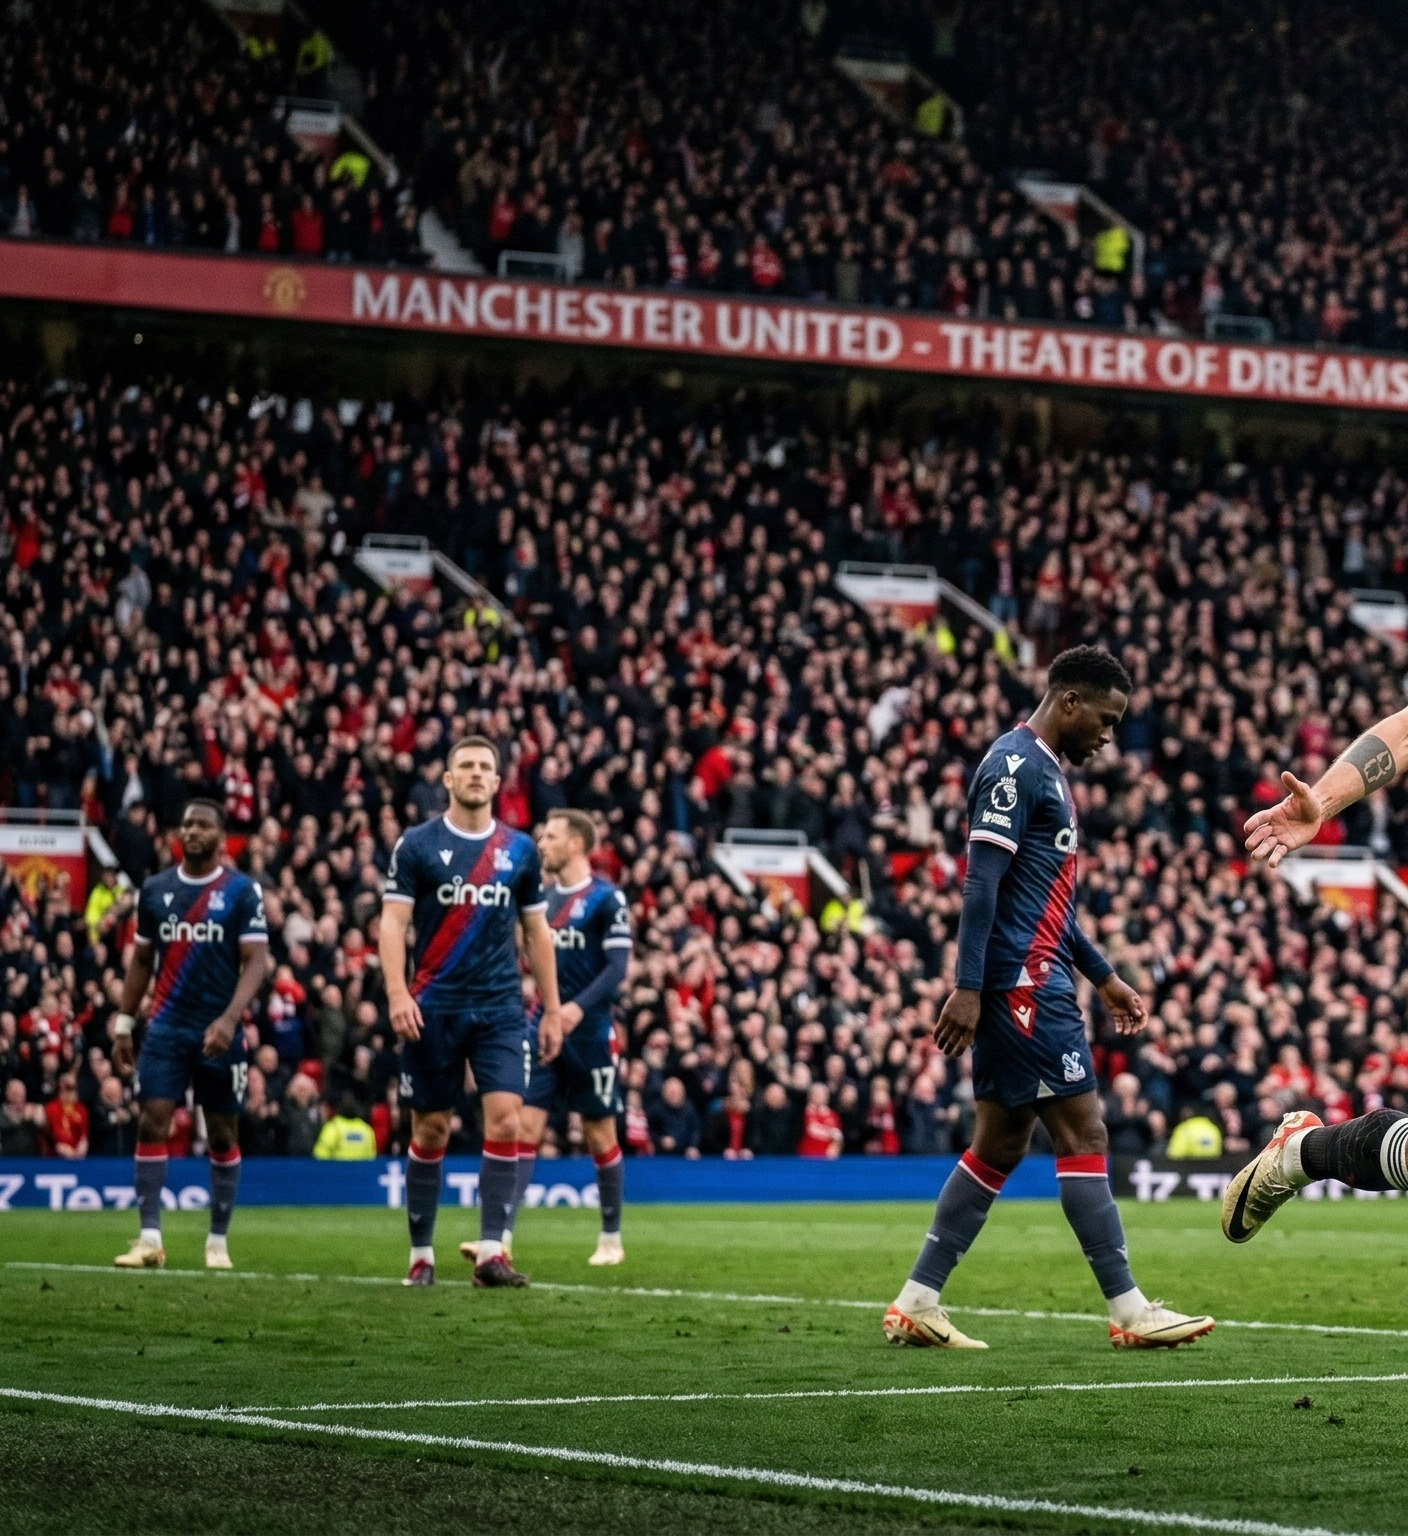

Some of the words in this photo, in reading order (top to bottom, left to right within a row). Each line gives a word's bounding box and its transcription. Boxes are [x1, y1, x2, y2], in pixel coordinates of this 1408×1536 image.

[353, 273, 702, 345] MANCHESTER
[716, 304, 902, 362] UNITED
[941, 323, 1146, 384] THEATER
[1156, 342, 1219, 389] OF
[437, 875, 511, 907] cinch
[159, 913, 224, 943] cinch
[591, 1066, 616, 1098] 17
